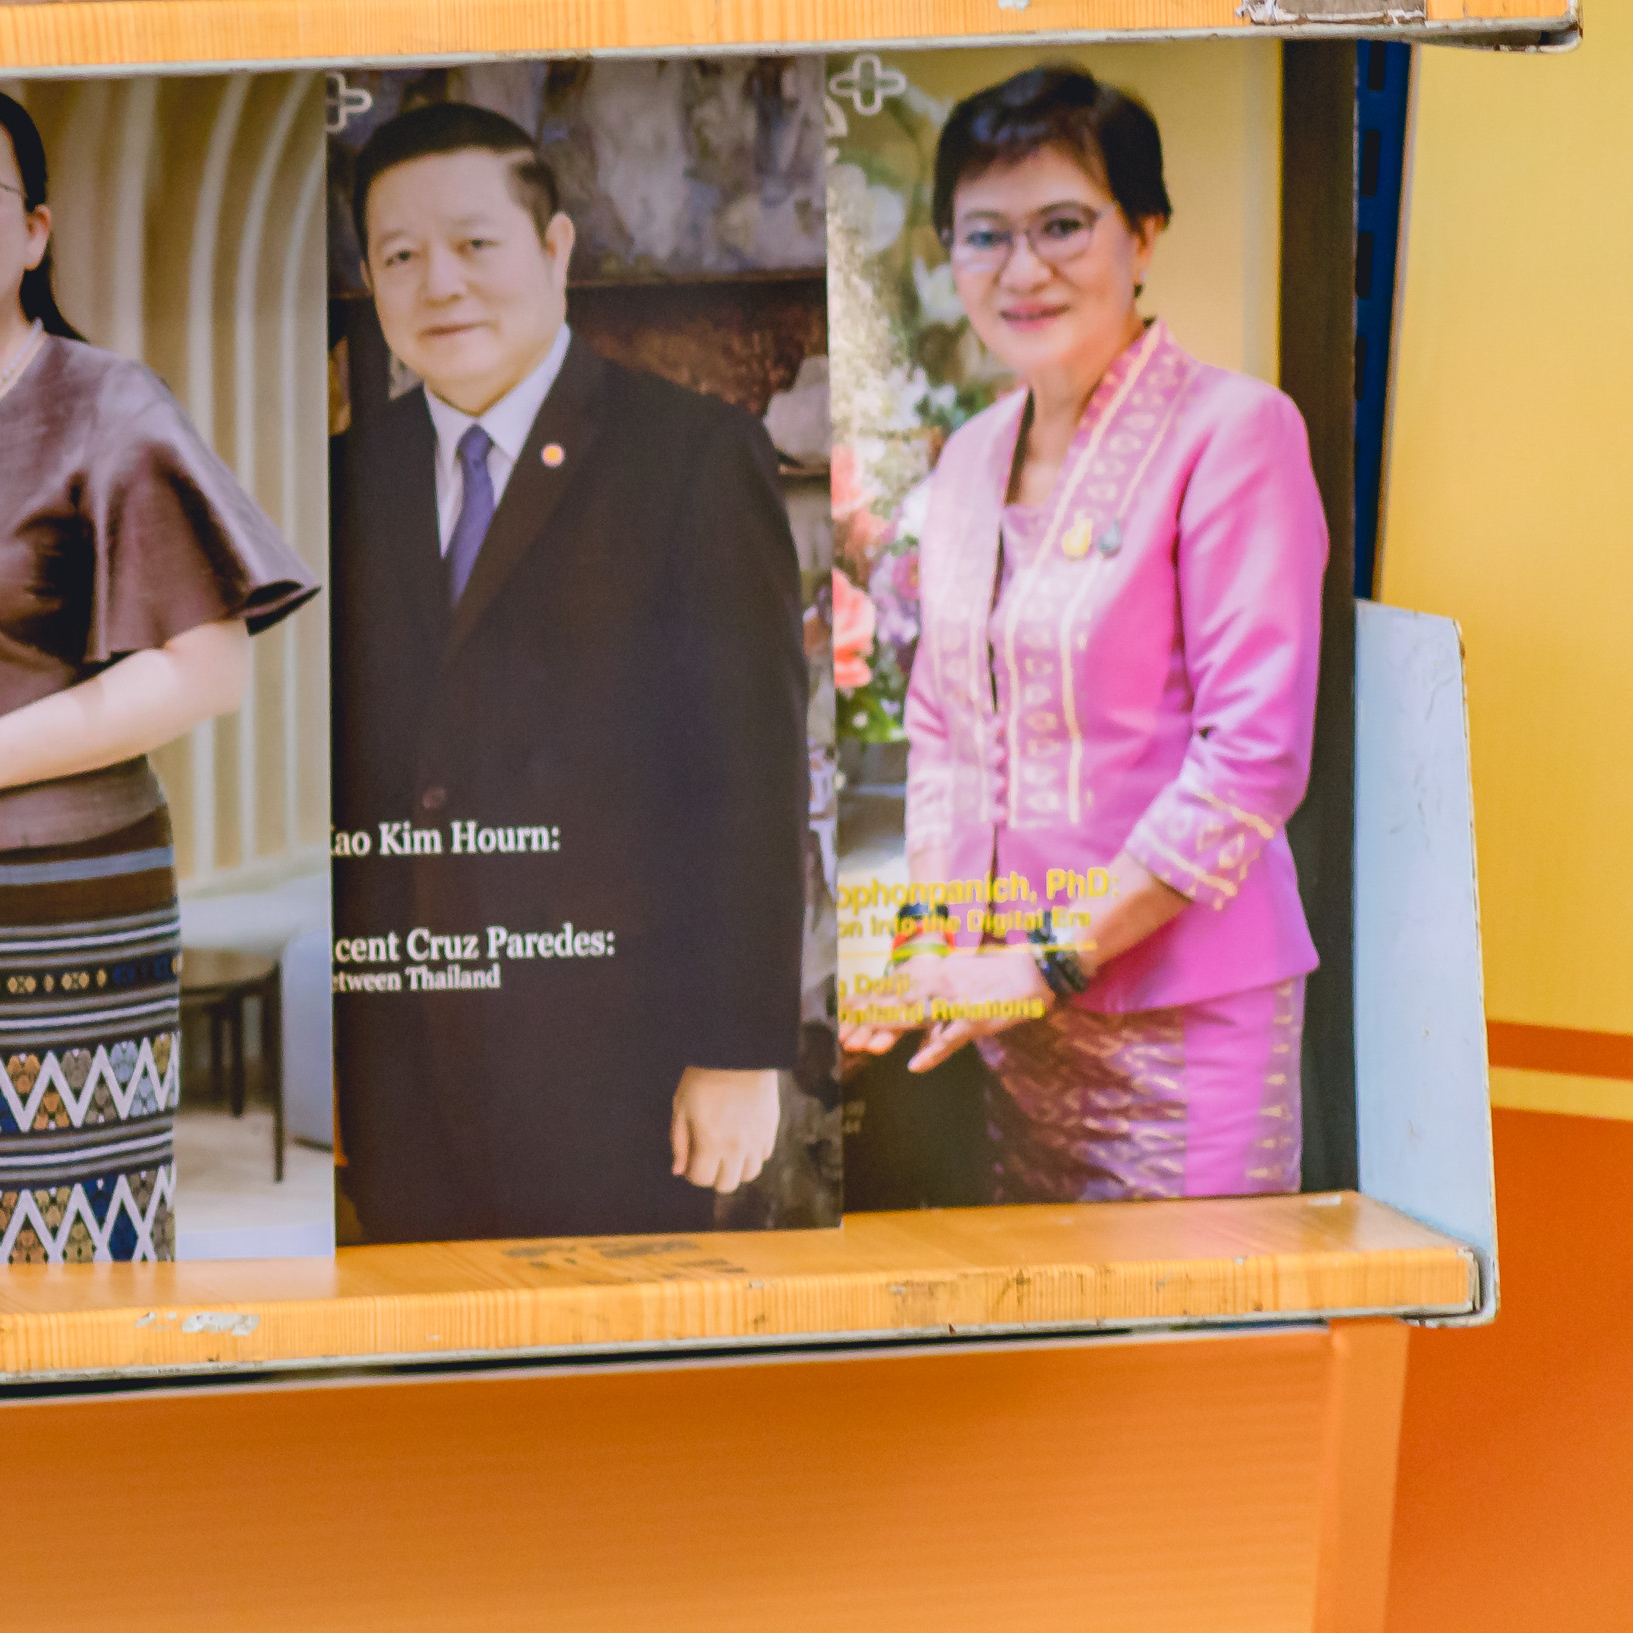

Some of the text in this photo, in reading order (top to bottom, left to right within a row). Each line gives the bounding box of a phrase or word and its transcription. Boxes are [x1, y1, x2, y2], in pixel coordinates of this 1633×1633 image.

[379, 819, 561, 856] Kim Hourn:
[406, 922, 616, 960] Cruz Paredes:
